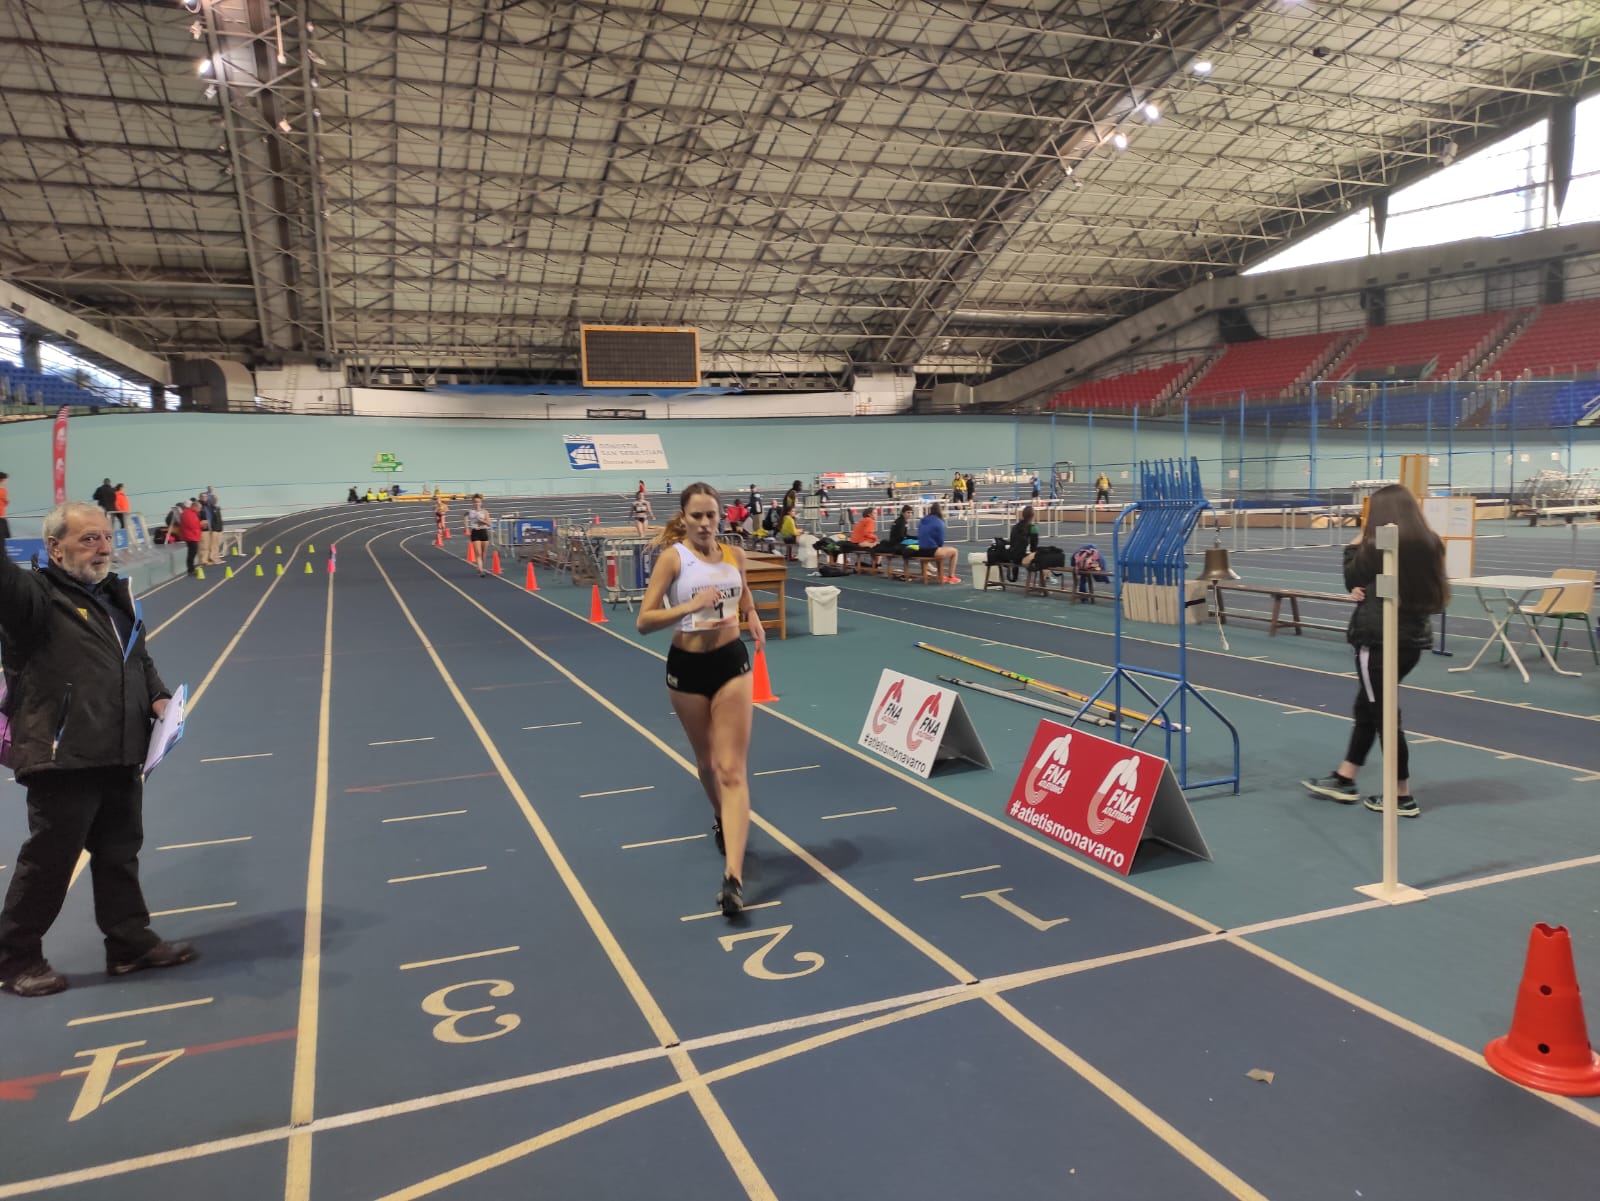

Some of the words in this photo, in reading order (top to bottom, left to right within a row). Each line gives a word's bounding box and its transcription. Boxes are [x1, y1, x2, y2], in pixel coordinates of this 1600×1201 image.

[883, 702, 903, 721] FNA
[919, 716, 941, 737] FNA
[864, 733, 927, 774] #atletismonavarro
[1041, 763, 1071, 788] FNA
[1102, 806, 1134, 824] ATLETISMO
[1106, 789, 1141, 817] FNA
[1009, 799, 1125, 868] #atletismonavarro
[960, 887, 1070, 932] 1
[717, 924, 826, 980] 2
[421, 979, 521, 1044] 3
[61, 1040, 185, 1122] 4
